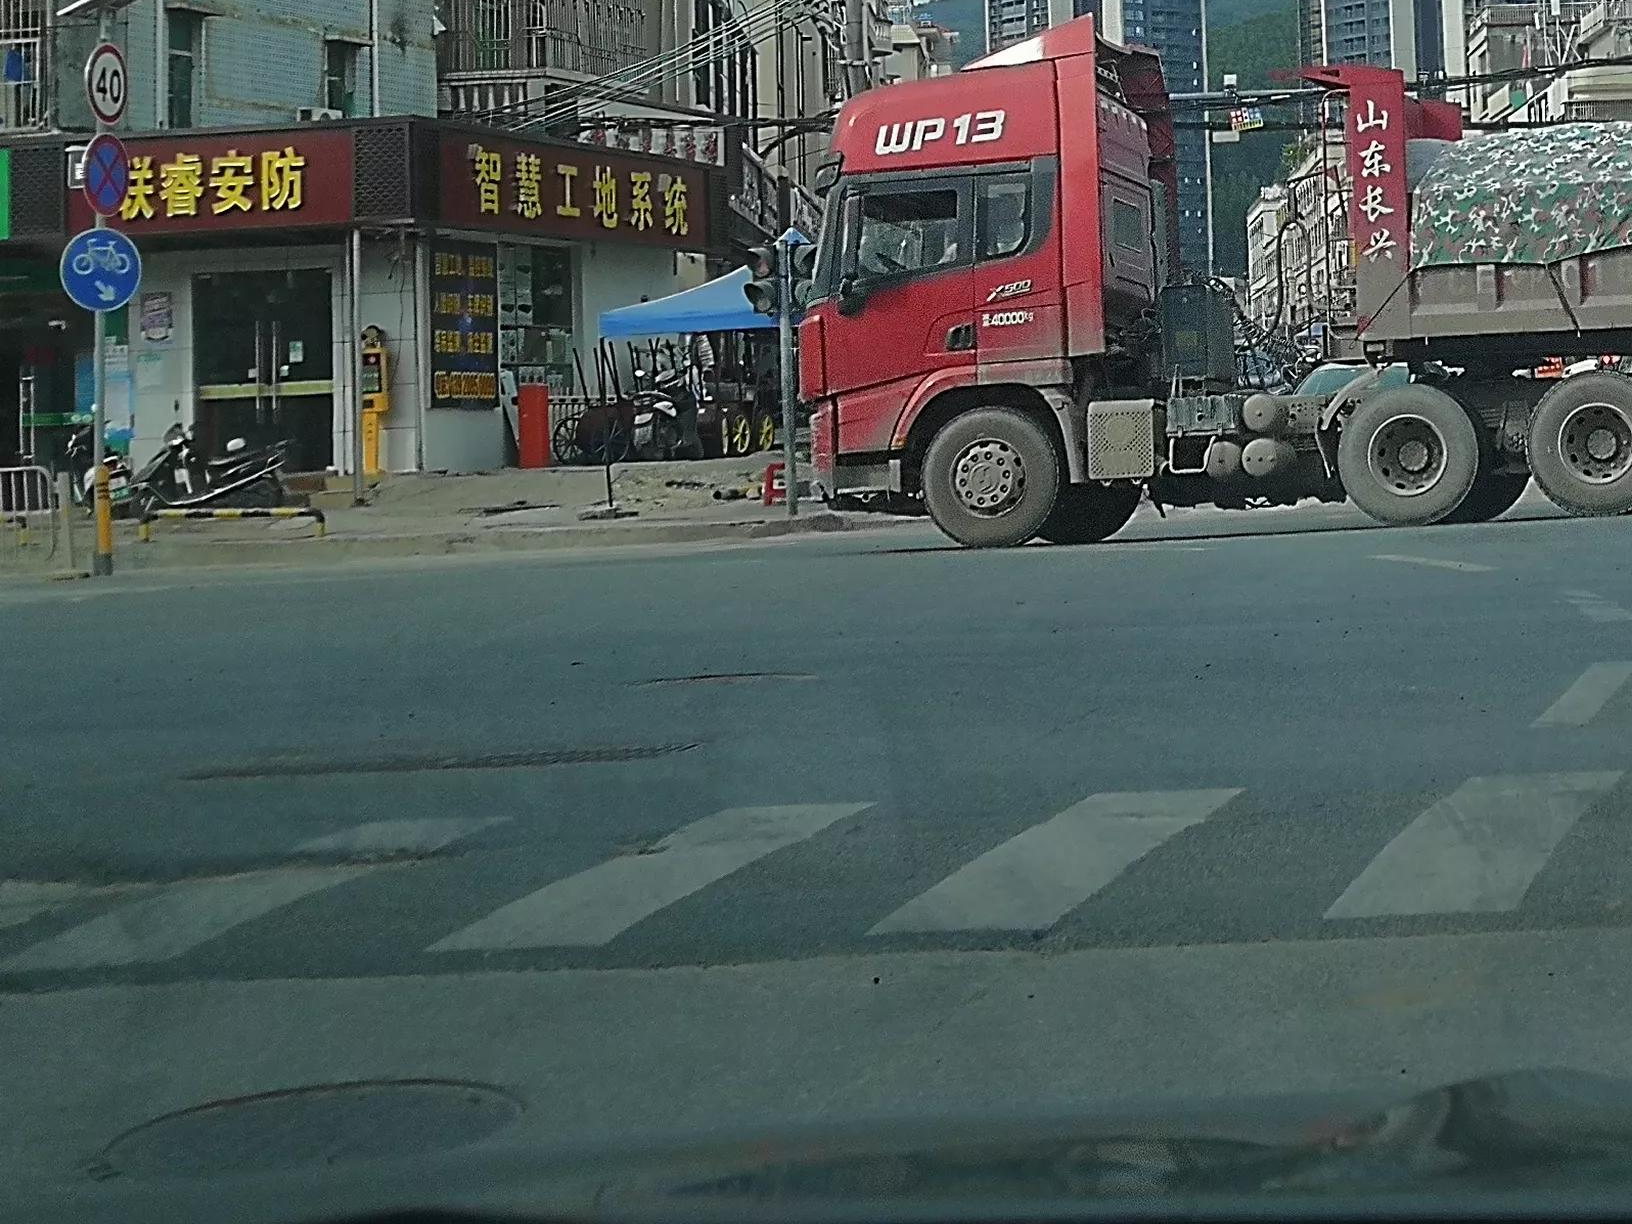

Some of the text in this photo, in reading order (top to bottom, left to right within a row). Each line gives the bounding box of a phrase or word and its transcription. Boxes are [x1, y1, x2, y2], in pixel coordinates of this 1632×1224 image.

[96, 67, 121, 104] 40
[474, 148, 688, 236] 智慧工地系统
[1357, 99, 1397, 263] 山东长兴
[986, 279, 1032, 302] X500
